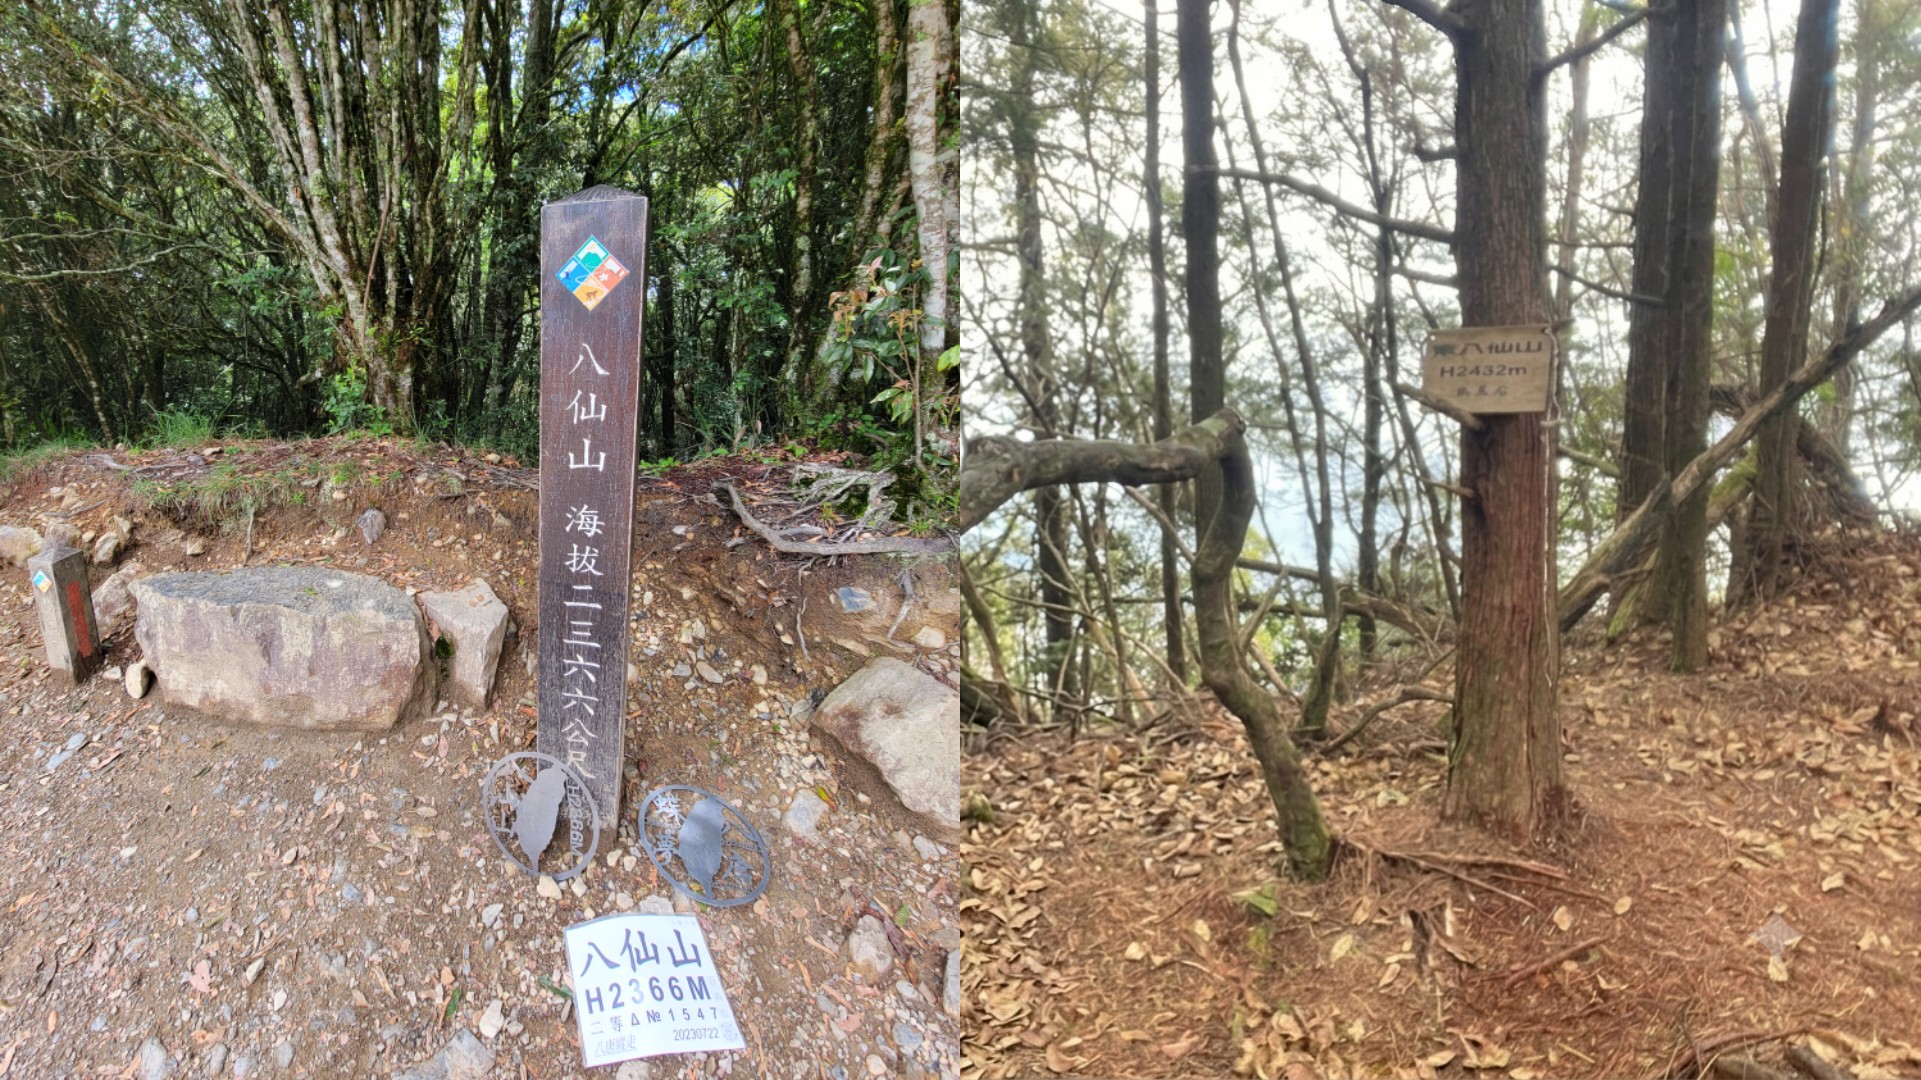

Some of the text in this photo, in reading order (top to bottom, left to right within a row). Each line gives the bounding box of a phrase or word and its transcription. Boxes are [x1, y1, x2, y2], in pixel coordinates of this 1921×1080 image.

[1440, 365, 1527, 377] H2432m
[561, 343, 610, 779] 八仙山 海拔二三六六公尺
[580, 928, 702, 977] 八仙山
[585, 976, 711, 1014] H2366M
[673, 1027, 720, 1041] 20230722
